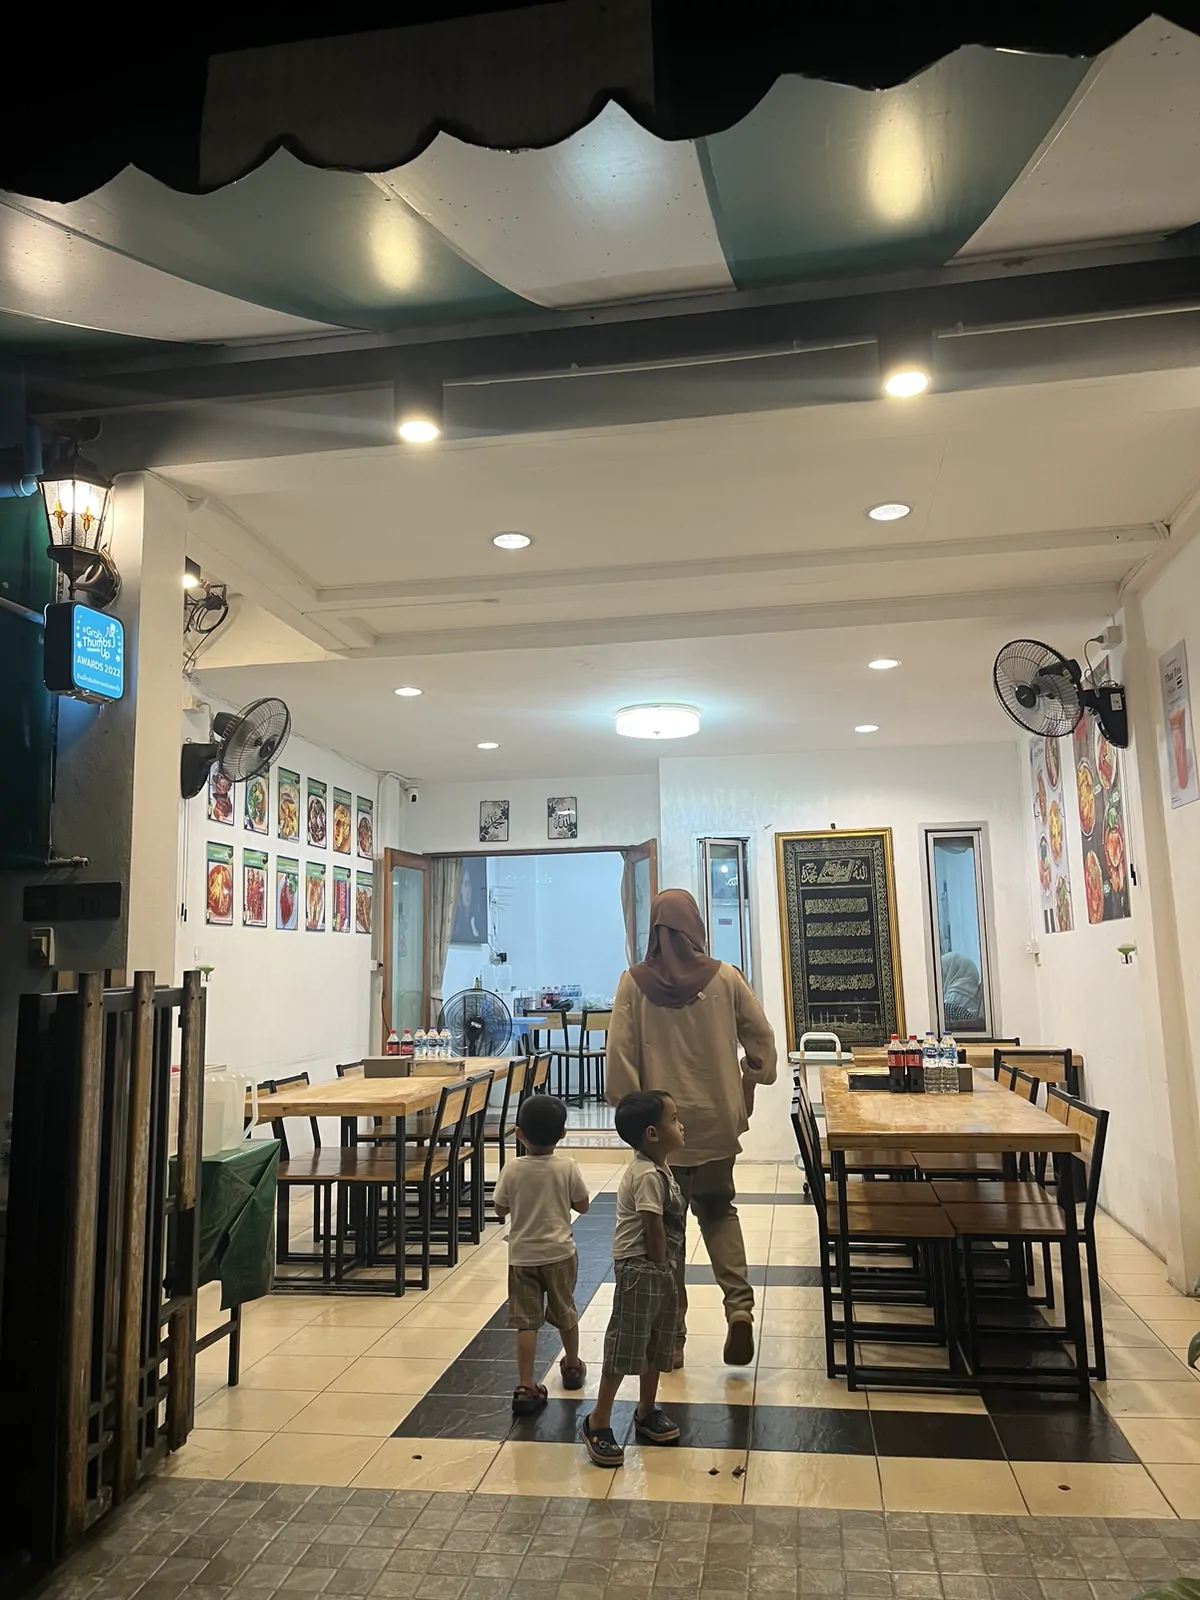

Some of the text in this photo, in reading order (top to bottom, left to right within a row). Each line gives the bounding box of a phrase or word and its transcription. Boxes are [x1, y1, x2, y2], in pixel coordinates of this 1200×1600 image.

[82, 636, 112, 648] Thumbs
[100, 646, 111, 660] Up
[77, 655, 121, 677] AWARDS 2022
